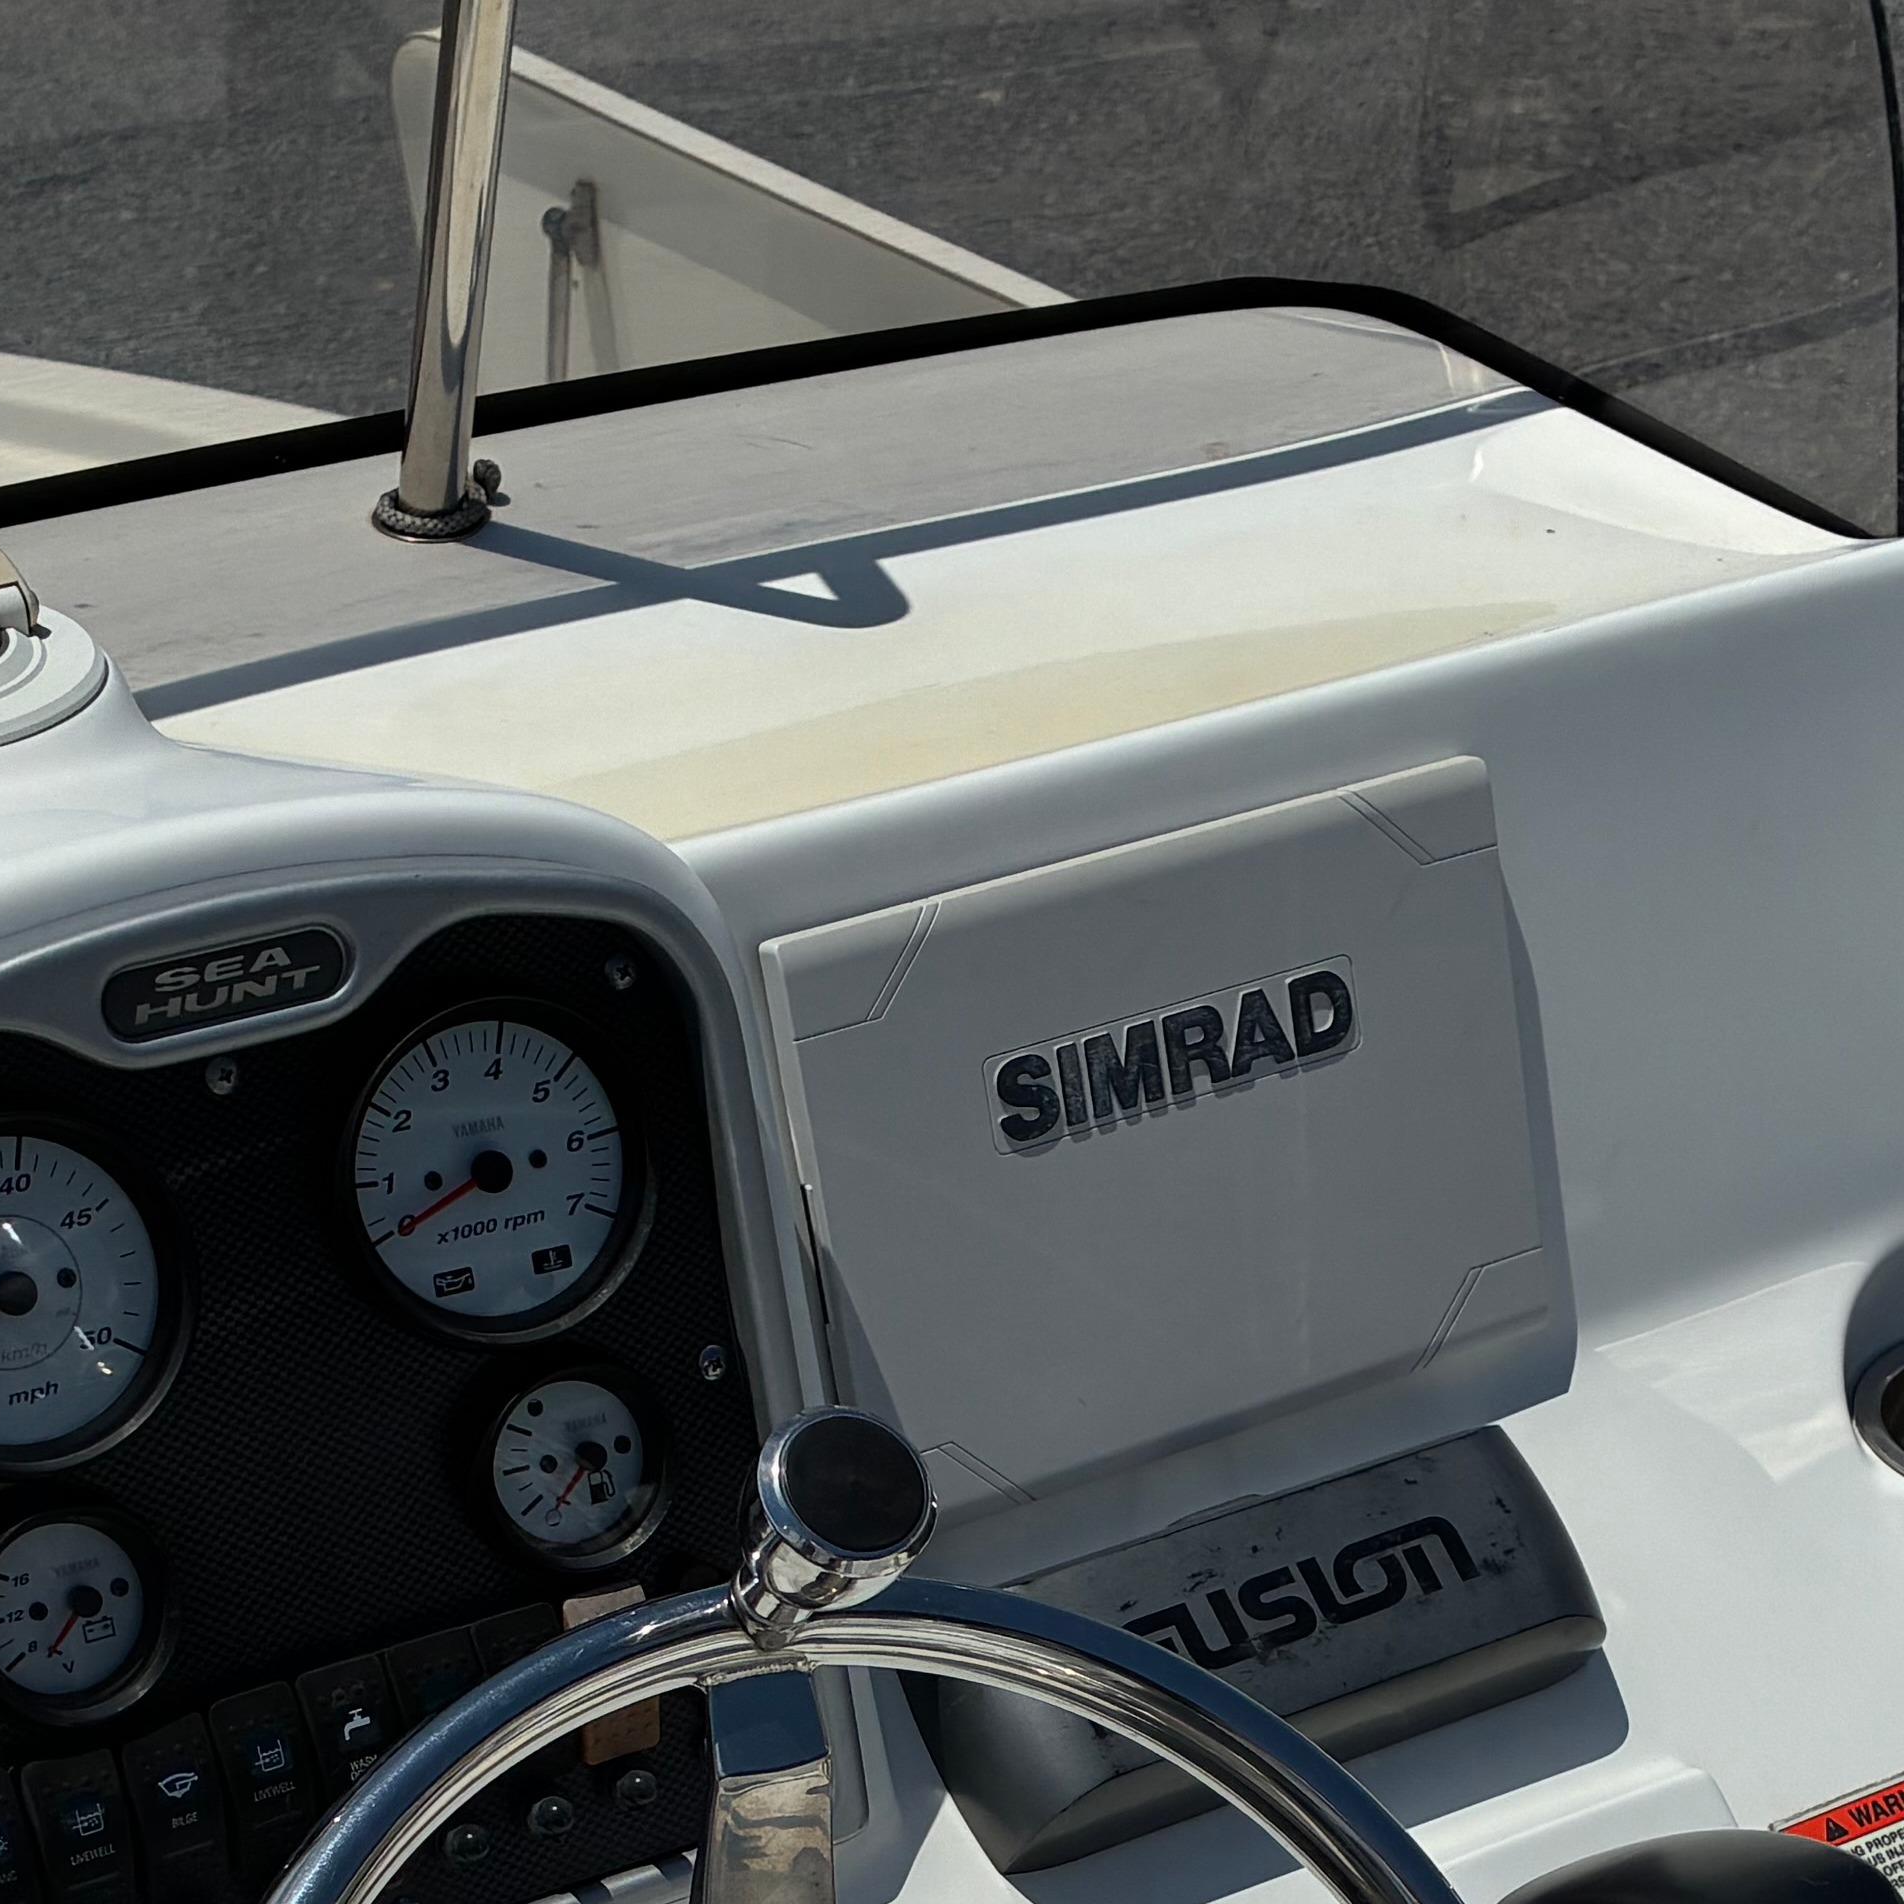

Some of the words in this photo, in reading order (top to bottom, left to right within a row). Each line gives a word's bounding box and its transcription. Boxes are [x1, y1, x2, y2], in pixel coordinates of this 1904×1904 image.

[154, 947, 291, 992] SEA
[134, 965, 321, 1025] HUNT
[995, 969, 1355, 1142] SIMRAD
[484, 1057, 503, 1080] 4
[431, 1069, 449, 1092] 3
[531, 1080, 551, 1103] 5
[392, 1109, 412, 1133] 2
[452, 1116, 505, 1138] YAMAHA
[566, 1130, 585, 1152] 6
[382, 1173, 395, 1195] 1
[566, 1192, 585, 1216] 7
[60, 1207, 93, 1230] 45
[436, 1216, 498, 1245] x1000
[503, 1209, 545, 1232] rpm
[79, 1326, 112, 1349] 50
[8, 1380, 59, 1405] mph
[11, 1572, 30, 1588] 16
[6, 1609, 25, 1624] 12
[62, 1660, 75, 1673] V
